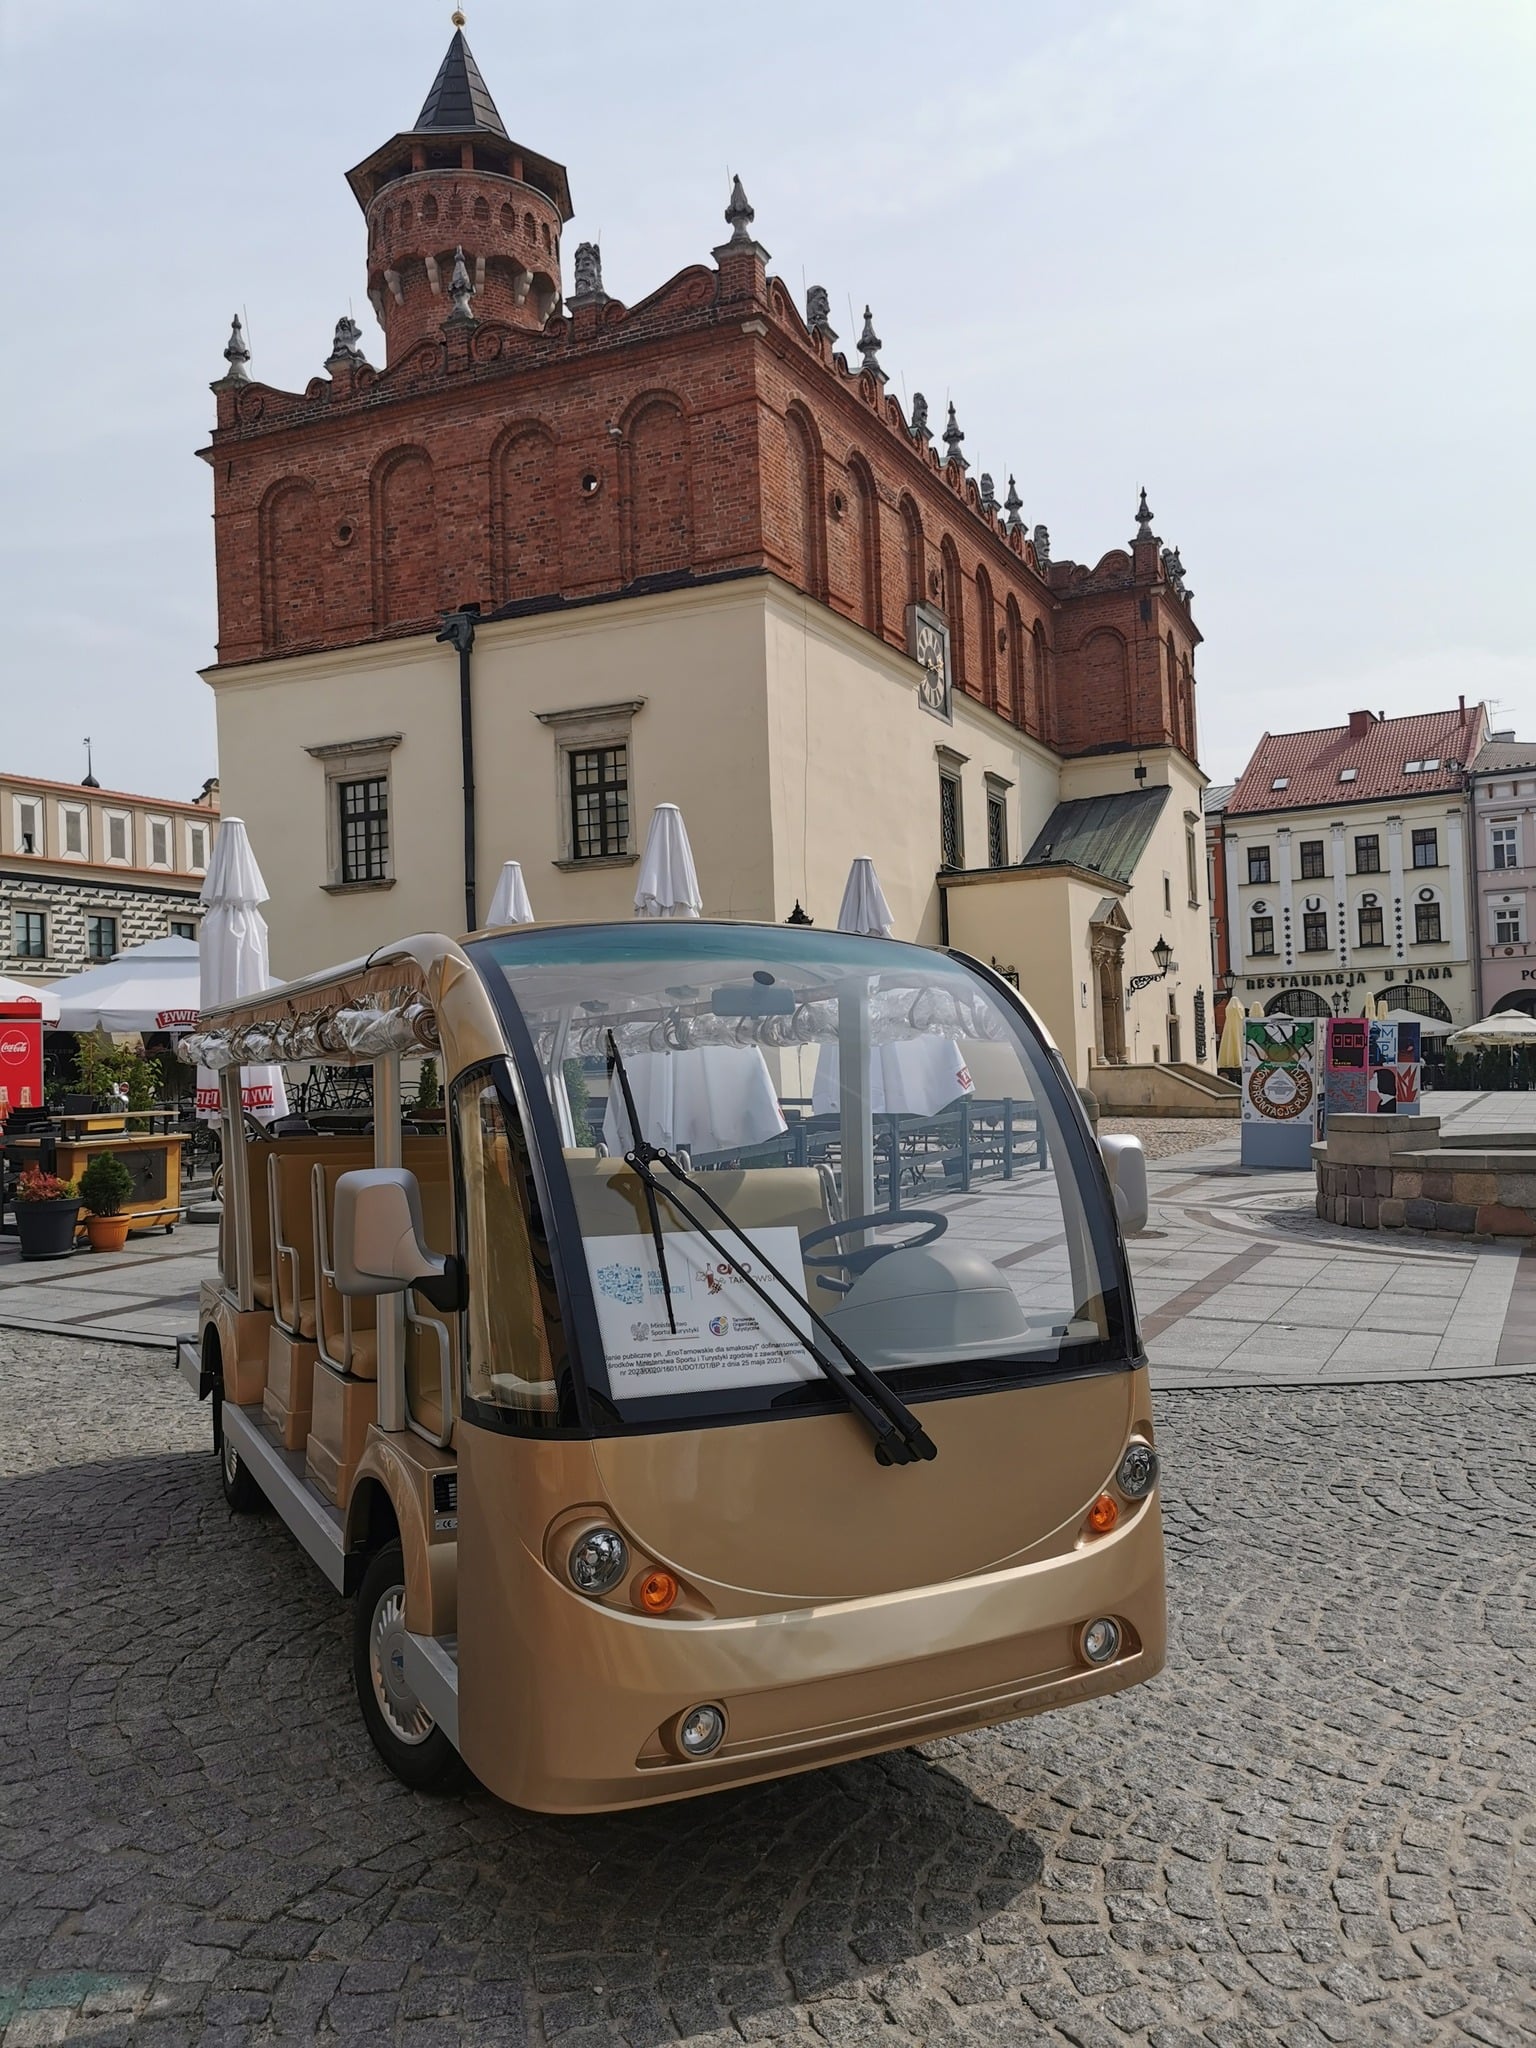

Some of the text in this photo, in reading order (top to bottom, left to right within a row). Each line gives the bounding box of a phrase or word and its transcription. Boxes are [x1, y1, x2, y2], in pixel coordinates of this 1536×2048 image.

[1246, 966, 1453, 990] RESTAURACJA U JANA
[676, 1326, 699, 1334] urystyki
[623, 1352, 652, 1361] publiczne
[636, 1358, 674, 1368] Ministerstwa
[675, 1356, 696, 1365] Sportu
[701, 1353, 728, 1362] Turystyki
[729, 1351, 753, 1360] zgodnie
[750, 1358, 765, 1367] maja
[767, 1357, 781, 1365] 2023
